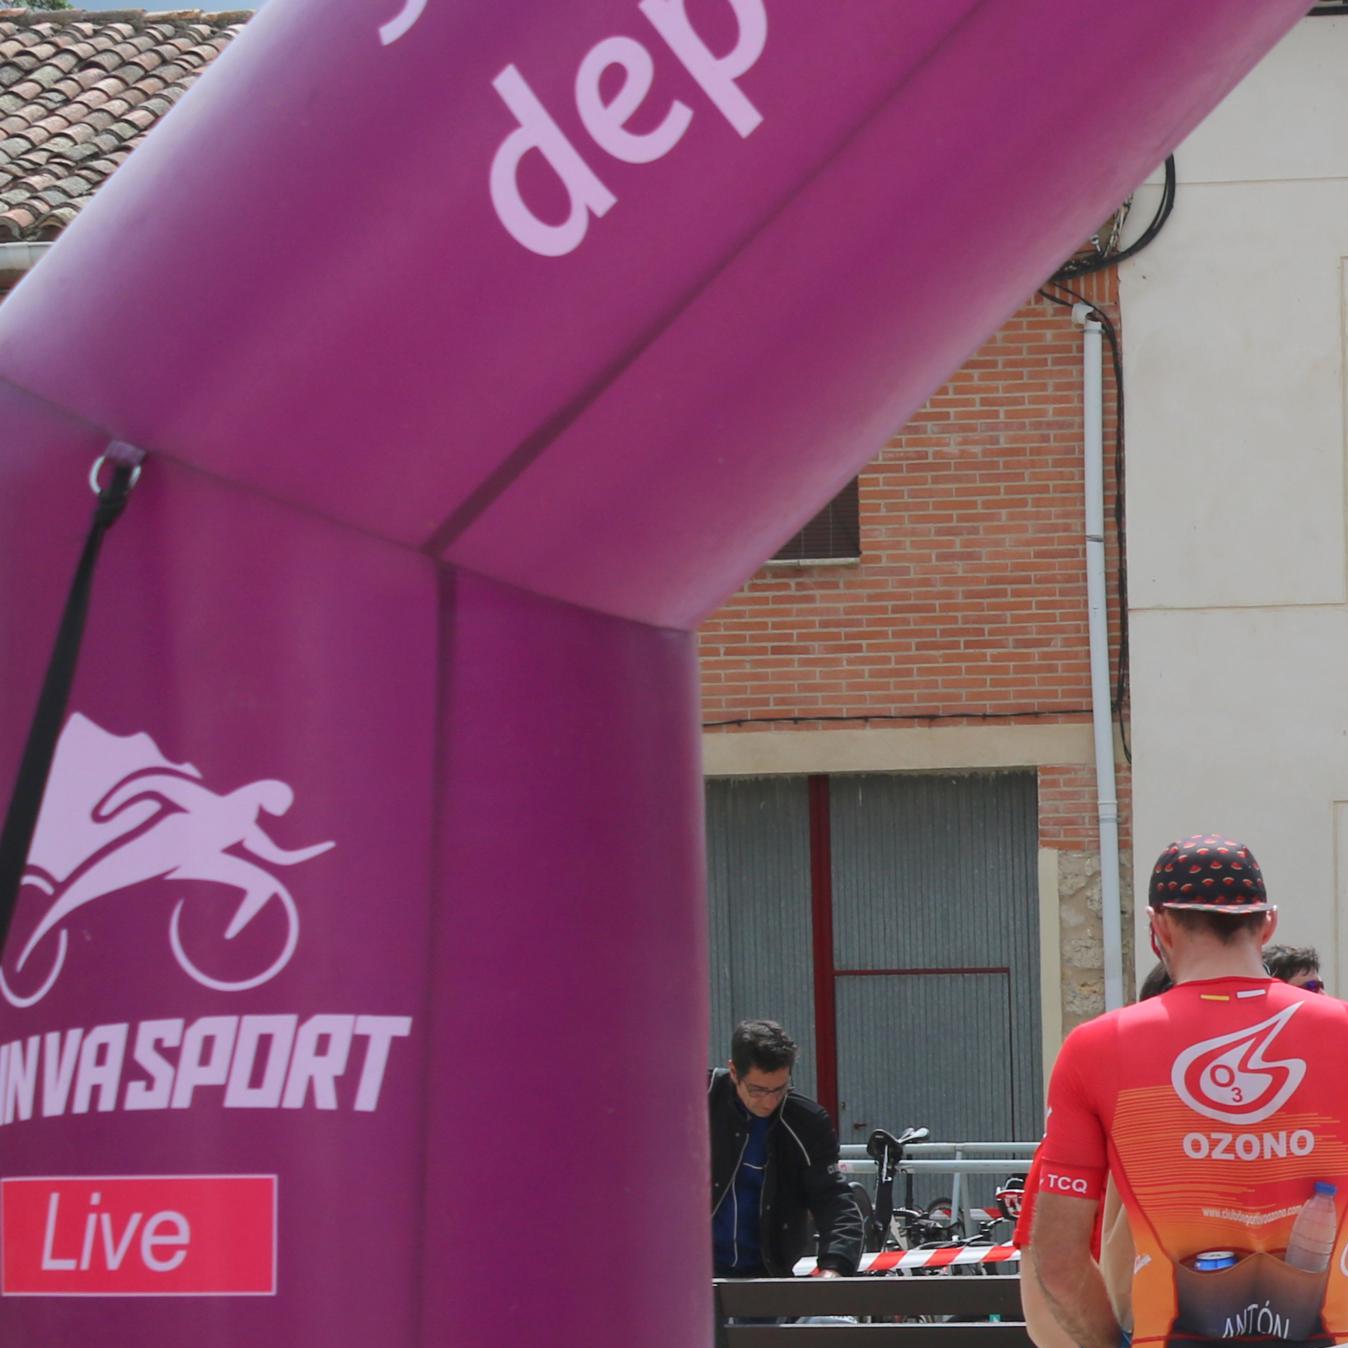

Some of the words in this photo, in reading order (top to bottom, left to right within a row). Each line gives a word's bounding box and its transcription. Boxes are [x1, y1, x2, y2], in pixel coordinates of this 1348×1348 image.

[0, 1014, 412, 1127] NVASPORT
[1182, 1129, 1315, 1161] OZONO
[1047, 1173, 1088, 1194] TCQ
[41, 1192, 191, 1271] Live
